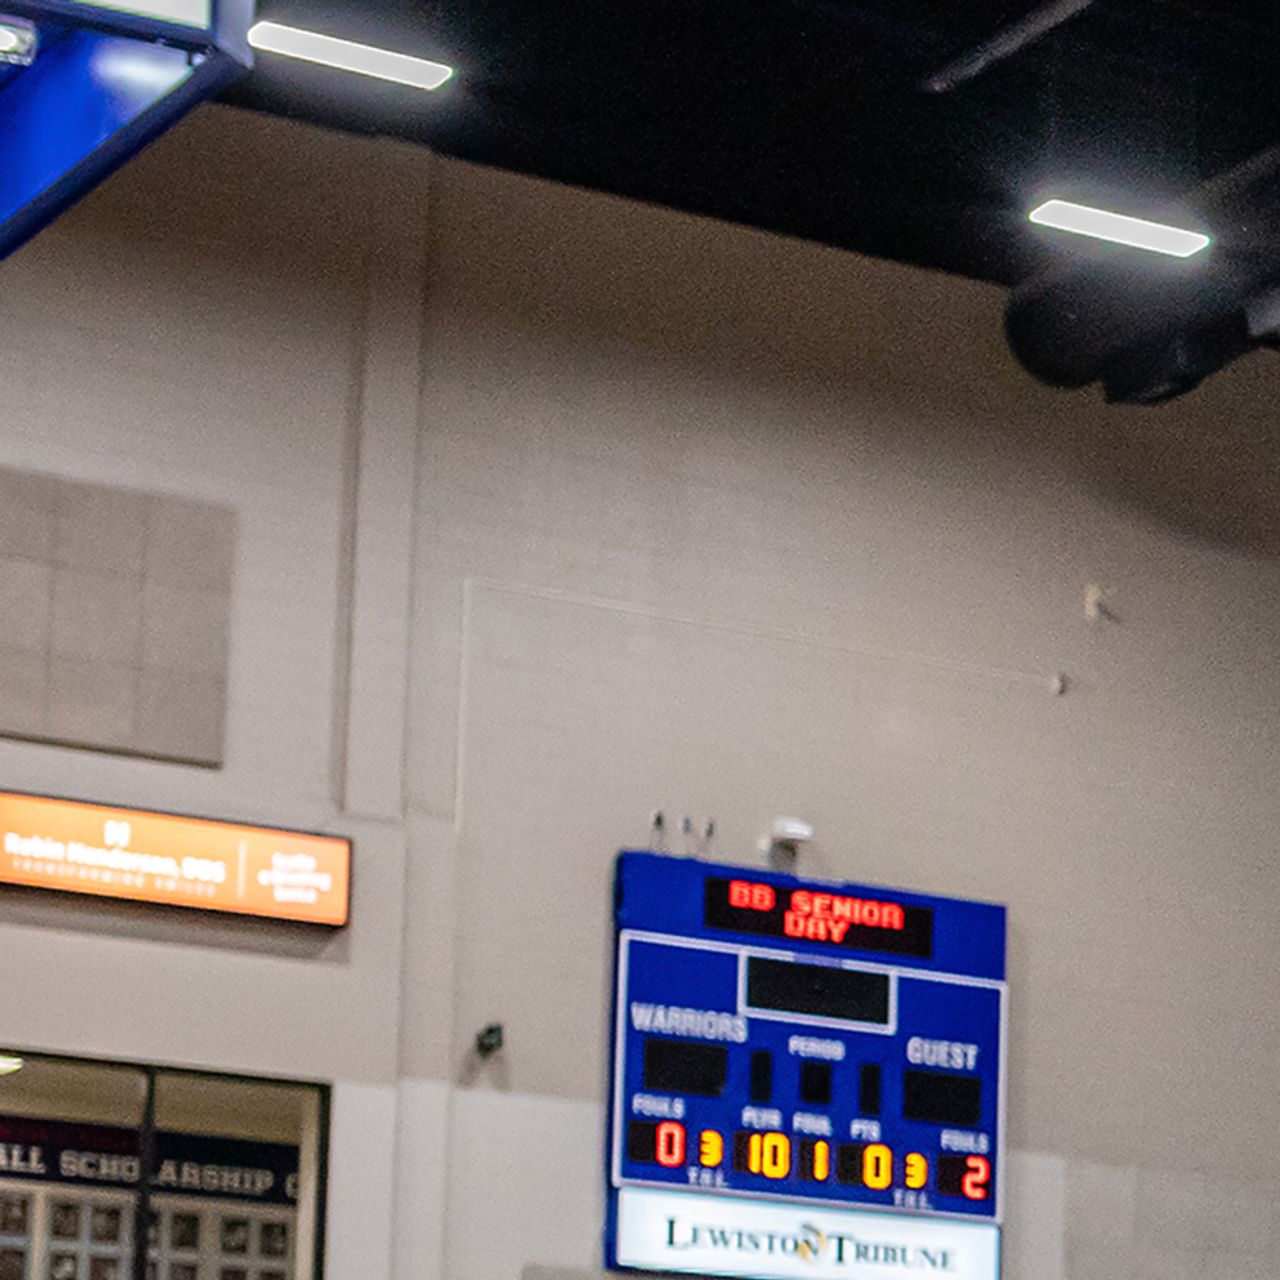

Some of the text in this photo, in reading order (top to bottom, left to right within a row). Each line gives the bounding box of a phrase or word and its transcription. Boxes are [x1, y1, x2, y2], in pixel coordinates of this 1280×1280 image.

[784, 910, 850, 943] DAY
[790, 890, 904, 930] SENIOR
[631, 1002, 748, 1043] WARRIORS
[788, 1035, 845, 1061] PERIOD
[907, 1036, 979, 1070] GUEST
[632, 1093, 685, 1119] FOULS
[656, 1121, 686, 1167] 0
[850, 1118, 881, 1141] PTS
[940, 1129, 989, 1154] FOULS
[700, 1130, 724, 1167] 3
[749, 1132, 790, 1179] 10
[813, 1140, 829, 1181] 1
[863, 1143, 892, 1190] 0
[59, 1150, 274, 1195] SCHOARSHIP
[905, 1153, 928, 1189] 3
[962, 1156, 990, 1199] 2
[826, 1234, 957, 1271] TRIBUNE
